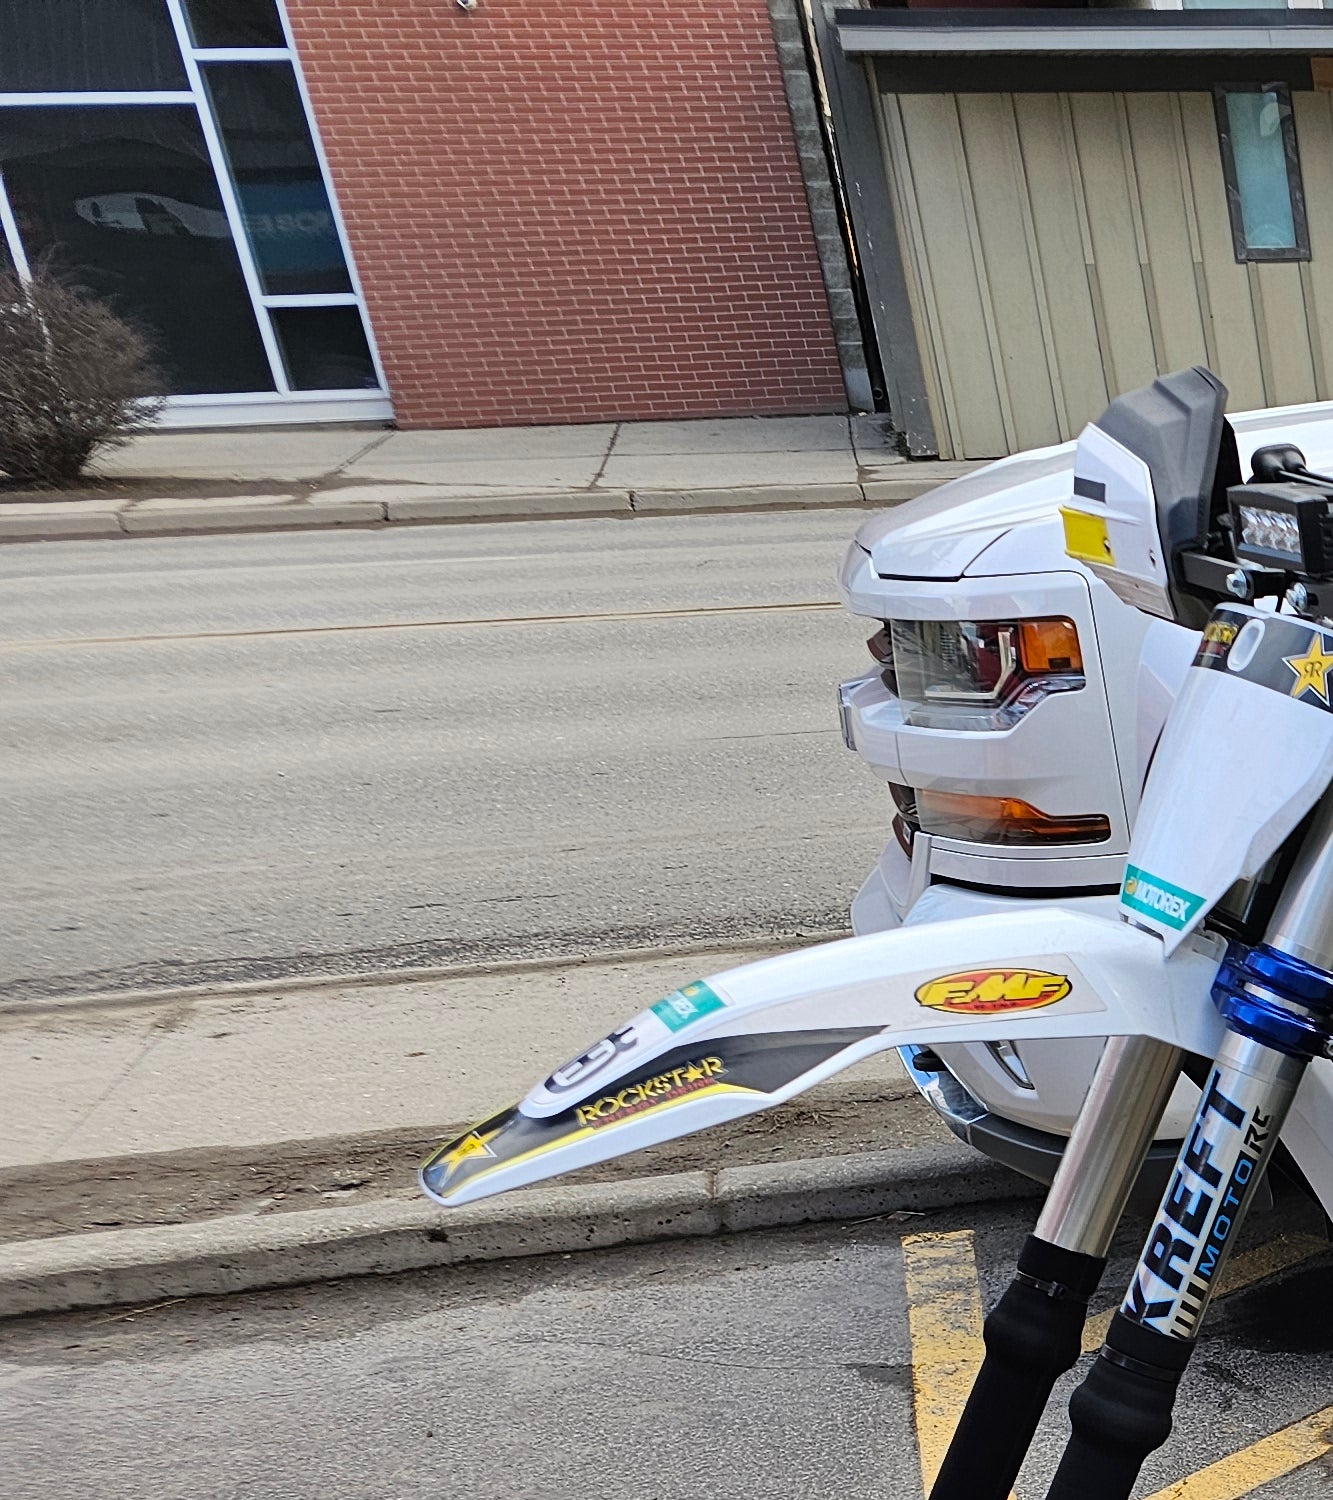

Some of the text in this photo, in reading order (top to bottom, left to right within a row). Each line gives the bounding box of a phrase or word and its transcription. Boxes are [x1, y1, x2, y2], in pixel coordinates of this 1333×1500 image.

[920, 974, 1068, 1007] FMF
[576, 1056, 729, 1126] ROCKSTAR
[1119, 1069, 1247, 1335] KREFT
[1198, 1158, 1254, 1277] MOTO
